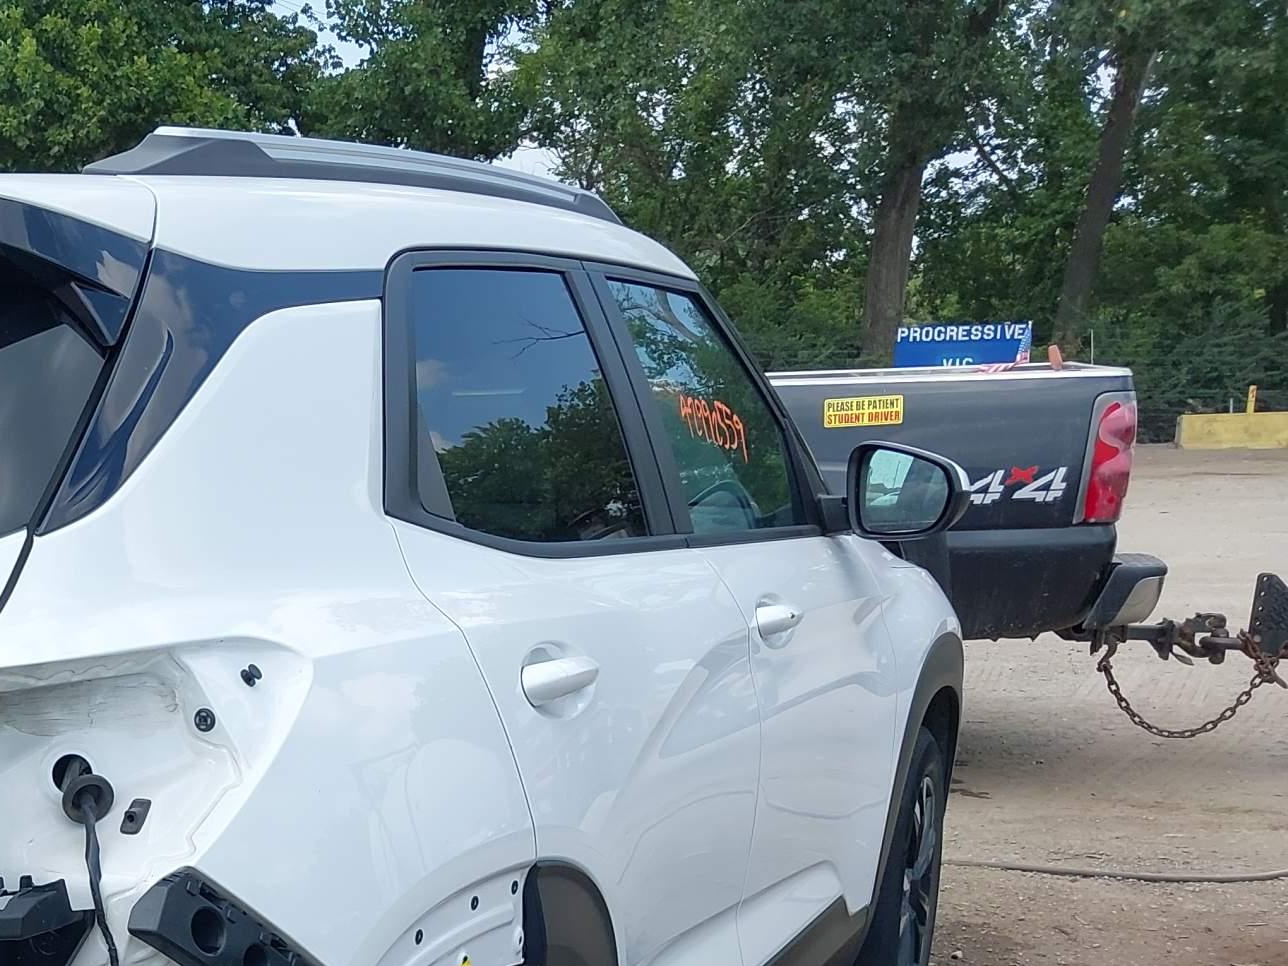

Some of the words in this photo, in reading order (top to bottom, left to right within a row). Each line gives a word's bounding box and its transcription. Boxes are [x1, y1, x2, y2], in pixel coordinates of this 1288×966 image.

[897, 324, 1027, 342] PROGRESSIVE
[827, 400, 854, 412] PLEASE
[855, 399, 866, 411] BE
[867, 398, 900, 410] PATIENT
[827, 412, 866, 425] STUDENT
[867, 410, 900, 423] DRIVER
